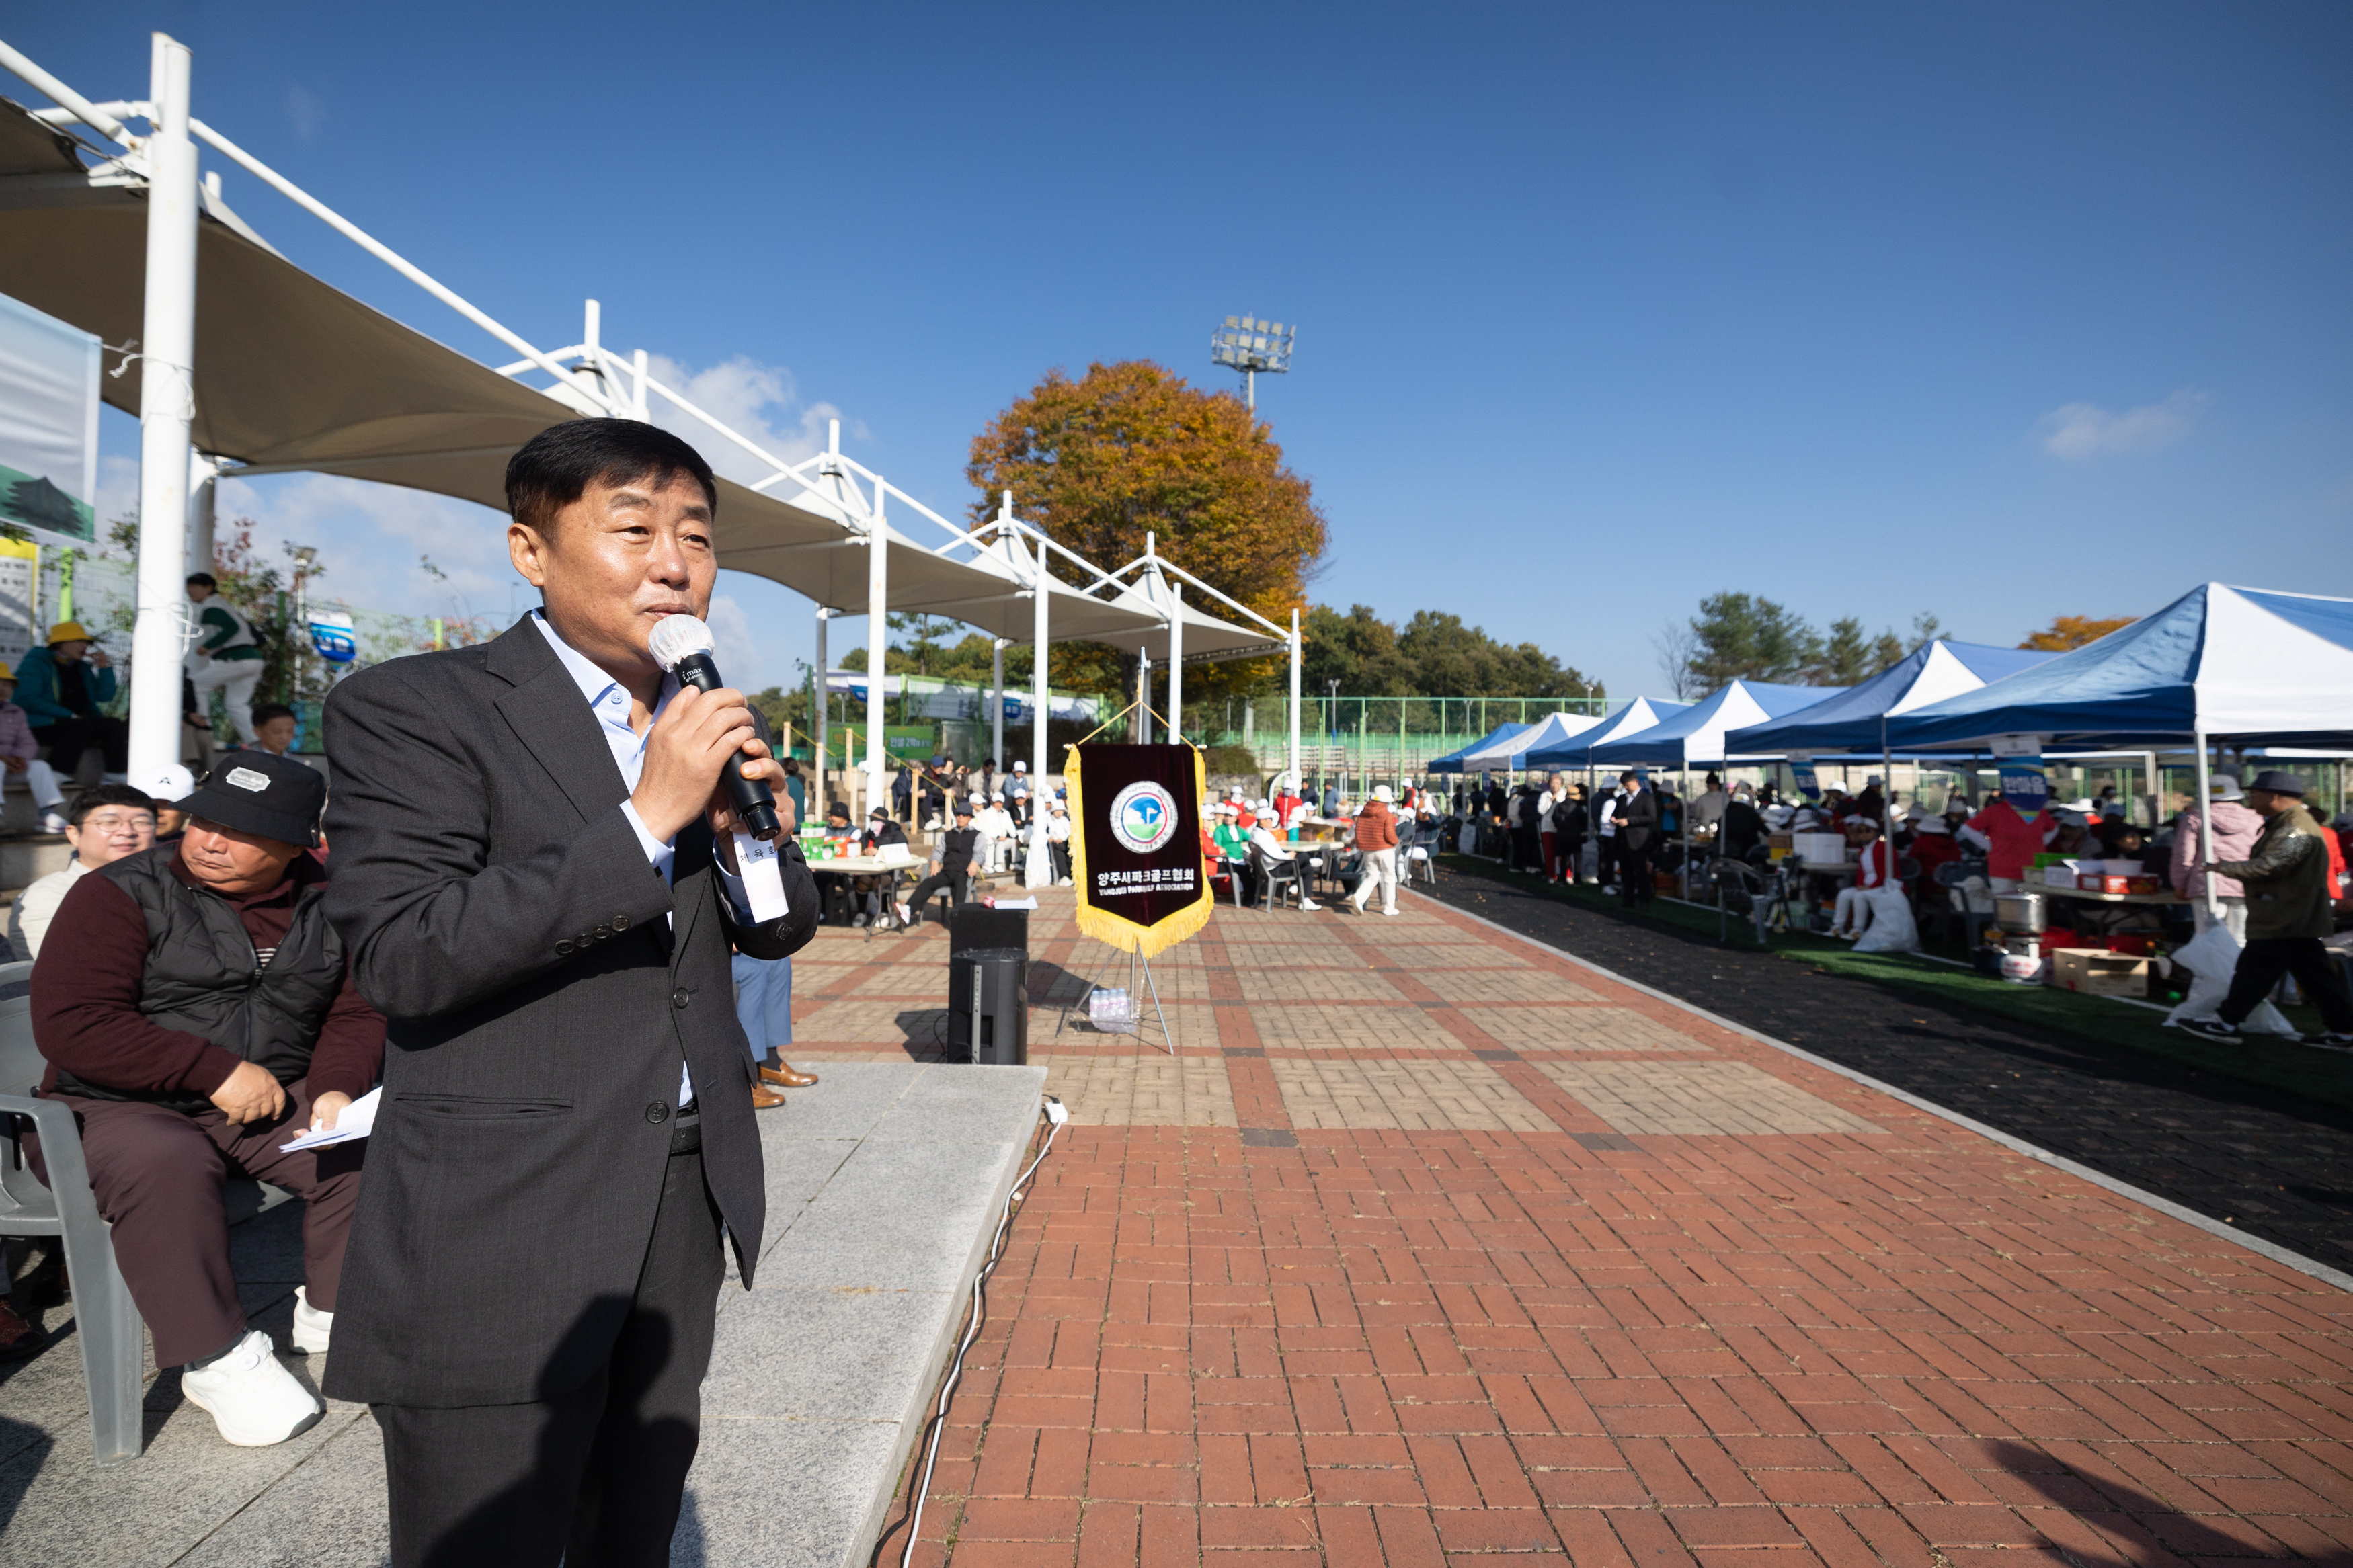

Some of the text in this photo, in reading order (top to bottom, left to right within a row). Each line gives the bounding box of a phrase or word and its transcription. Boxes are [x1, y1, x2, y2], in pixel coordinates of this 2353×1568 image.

[686, 667, 703, 677] max
[1097, 868, 1194, 886] 양주시파크골프협회
[1156, 883, 1194, 891] ASSOCIATION
